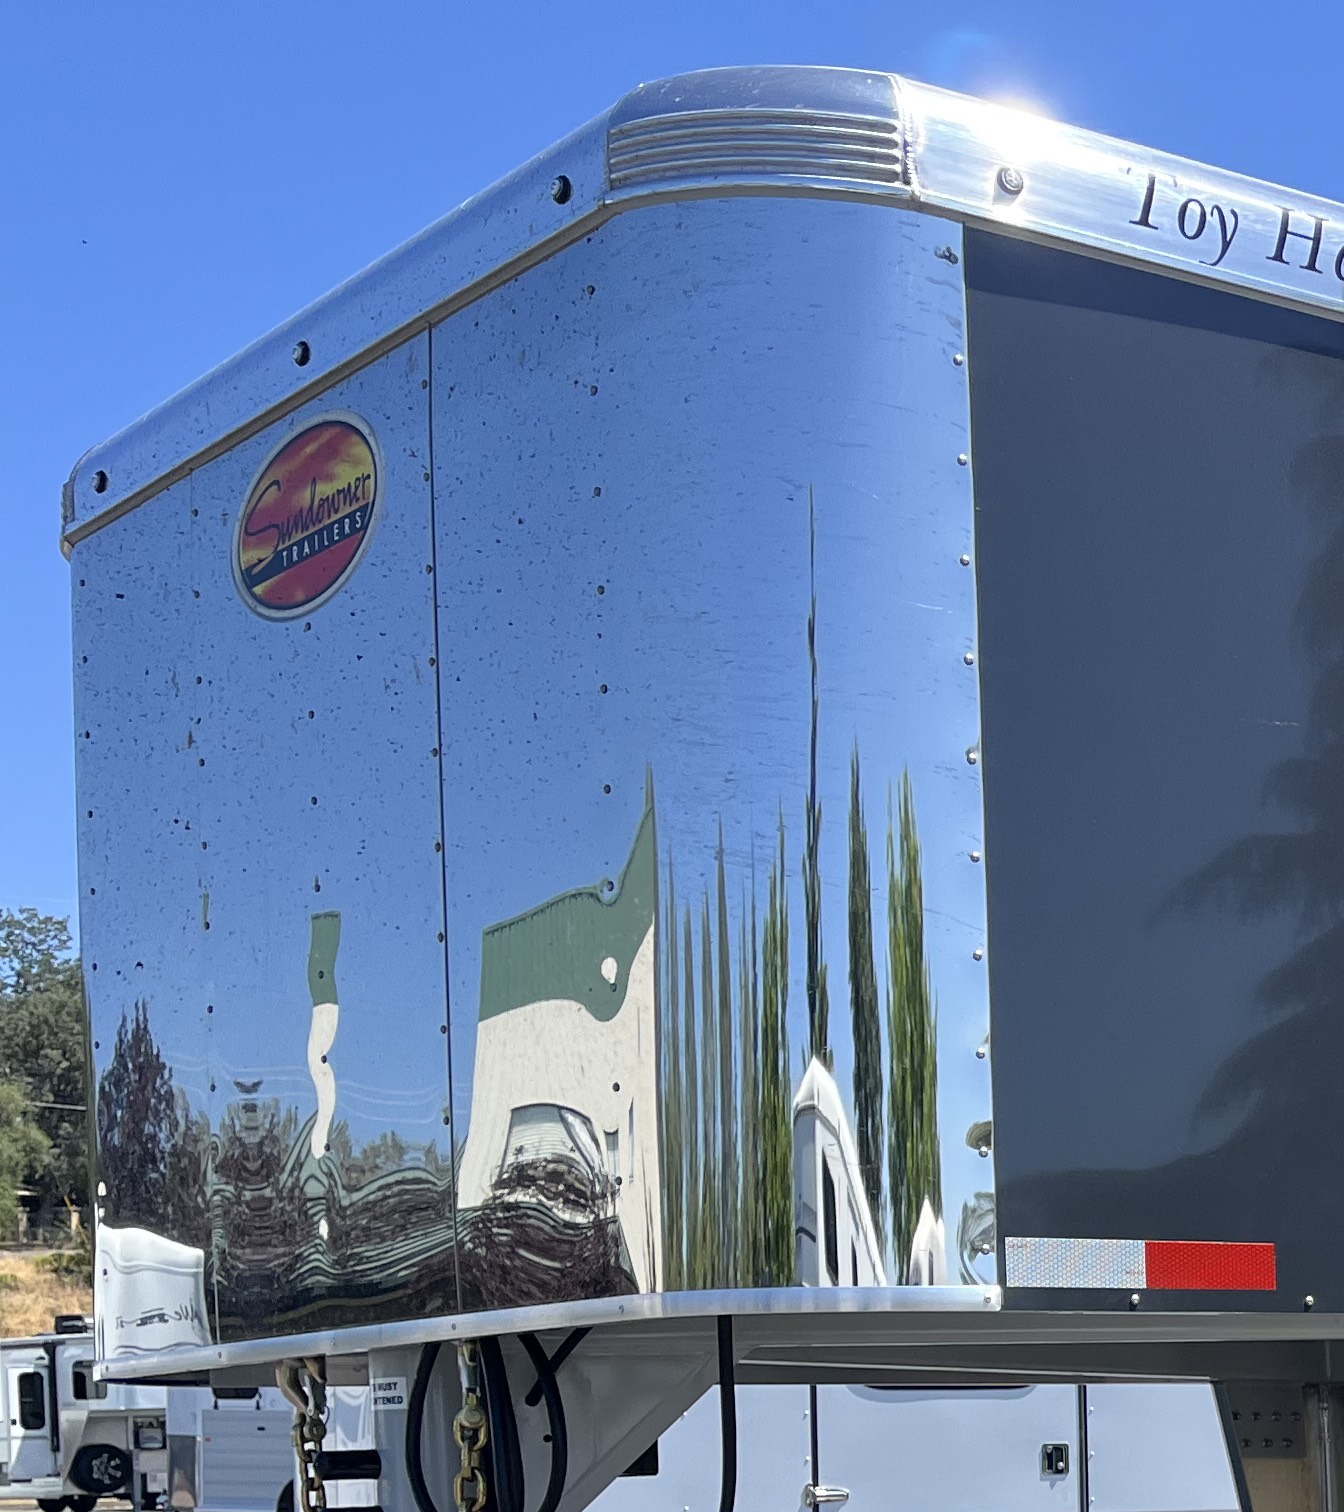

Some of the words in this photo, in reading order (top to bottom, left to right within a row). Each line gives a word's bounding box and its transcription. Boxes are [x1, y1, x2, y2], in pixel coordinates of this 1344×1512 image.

[1126, 167, 1239, 267] Toy
[245, 472, 371, 568] Sundowner
[281, 511, 362, 568] TRAILERS
